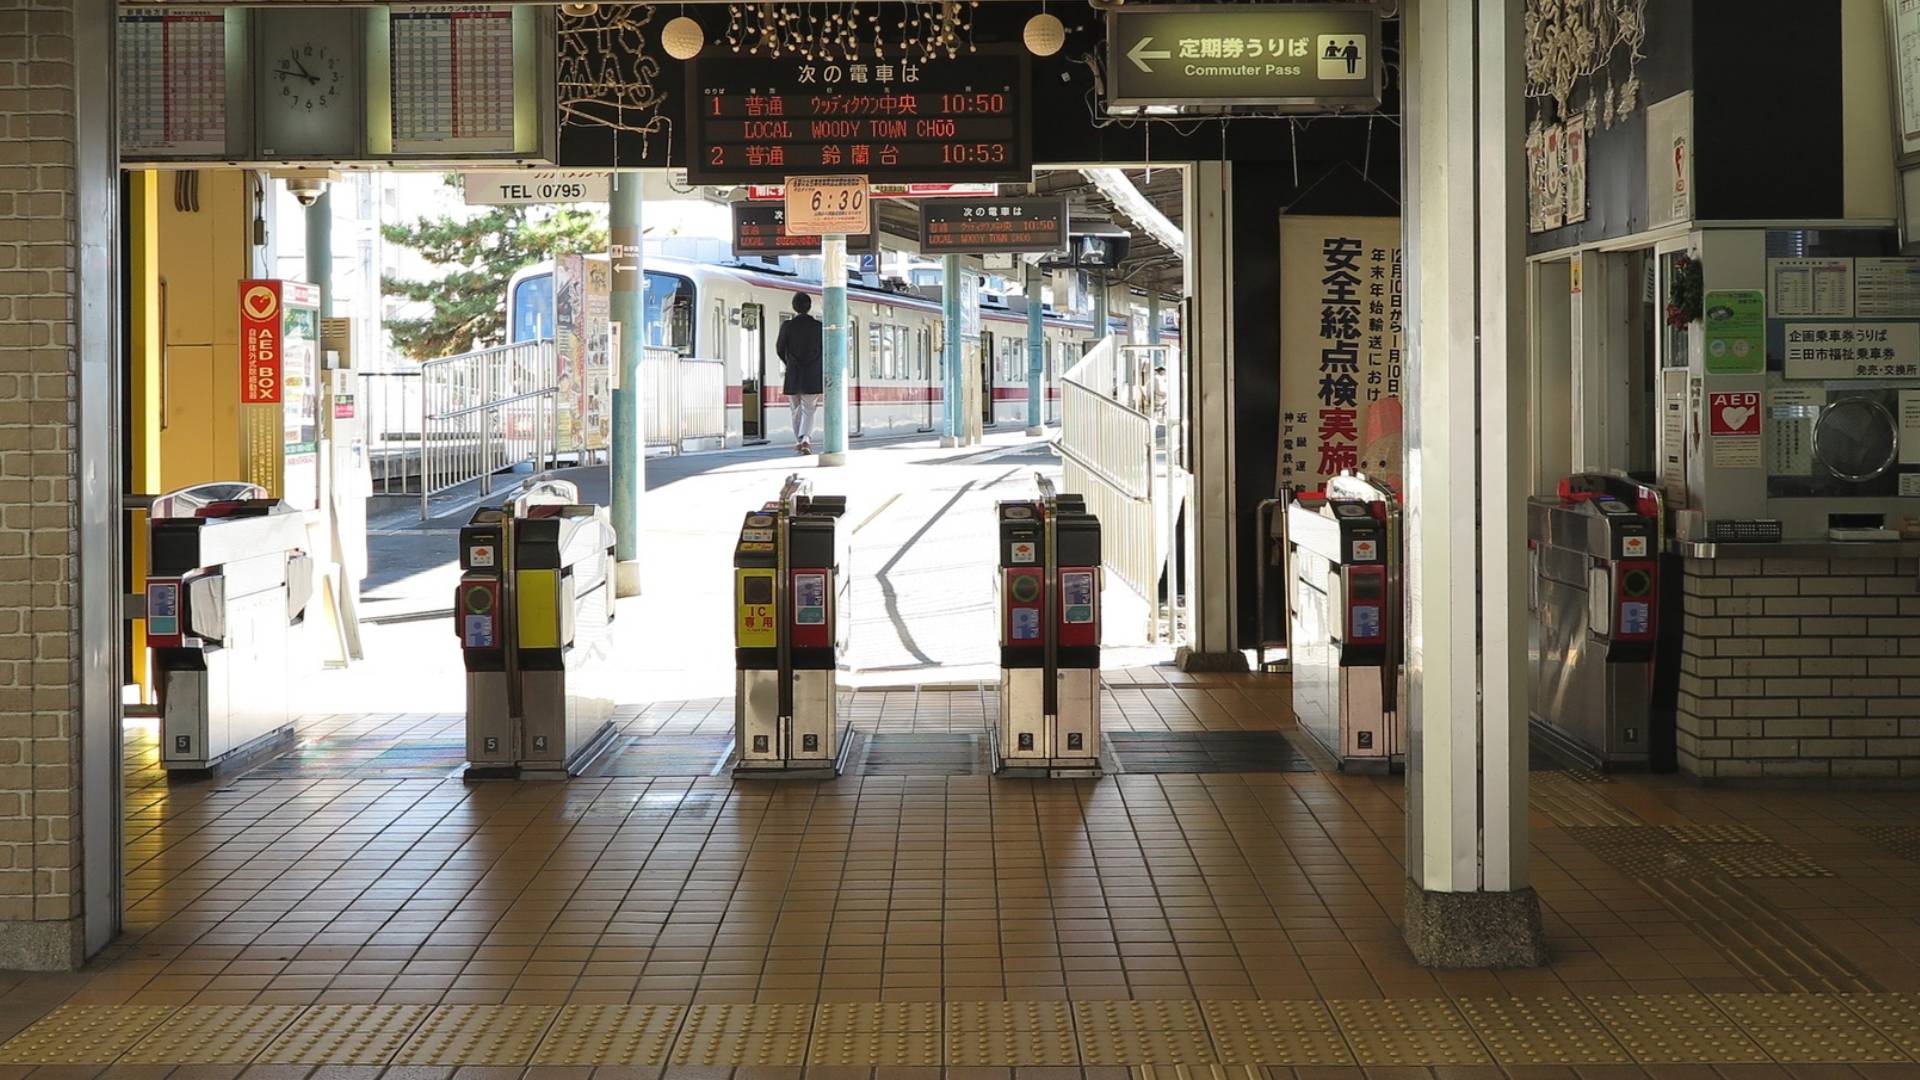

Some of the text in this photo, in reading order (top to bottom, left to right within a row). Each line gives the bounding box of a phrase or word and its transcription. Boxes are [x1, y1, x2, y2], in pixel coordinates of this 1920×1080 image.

[1178, 37, 1310, 59] 定期券うりば
[797, 64, 920, 83] 次の電車は
[1184, 64, 1301, 76] Commuter Pass
[710, 96, 721, 115] 1
[745, 96, 785, 116] 普通
[941, 94, 1004, 113] 10:50
[744, 121, 792, 137] LOCAL
[811, 120, 860, 137] WOODY
[871, 120, 907, 137] TOWN
[711, 144, 1004, 166] 2 普通 鈴蘭台 10:53
[500, 183, 587, 199] TEL (0795)
[811, 189, 863, 211] 6:30
[963, 206, 1022, 217] 次の電車は
[1023, 220, 1055, 231] 10:50
[863, 254, 873, 267] 2
[1388, 248, 1402, 399] 12月10日から1月10日
[1788, 329, 1888, 343] 企画乗車券うりば
[258, 328, 274, 361] AED
[1789, 348, 1895, 361] 三田市福祉乗車券
[1317, 237, 1363, 493] 安全総点検実施
[258, 367, 275, 399] BOX
[1714, 393, 1757, 406] AED
[750, 605, 767, 617] IC
[1022, 734, 1030, 744] 3
[1071, 734, 1079, 744] 2
[1361, 732, 1369, 743] 2
[1627, 728, 1634, 738] 1
[178, 737, 186, 748] 5
[488, 738, 495, 748] 5
[536, 737, 543, 747] 4
[757, 736, 765, 746] 4
[807, 735, 814, 745] 3
